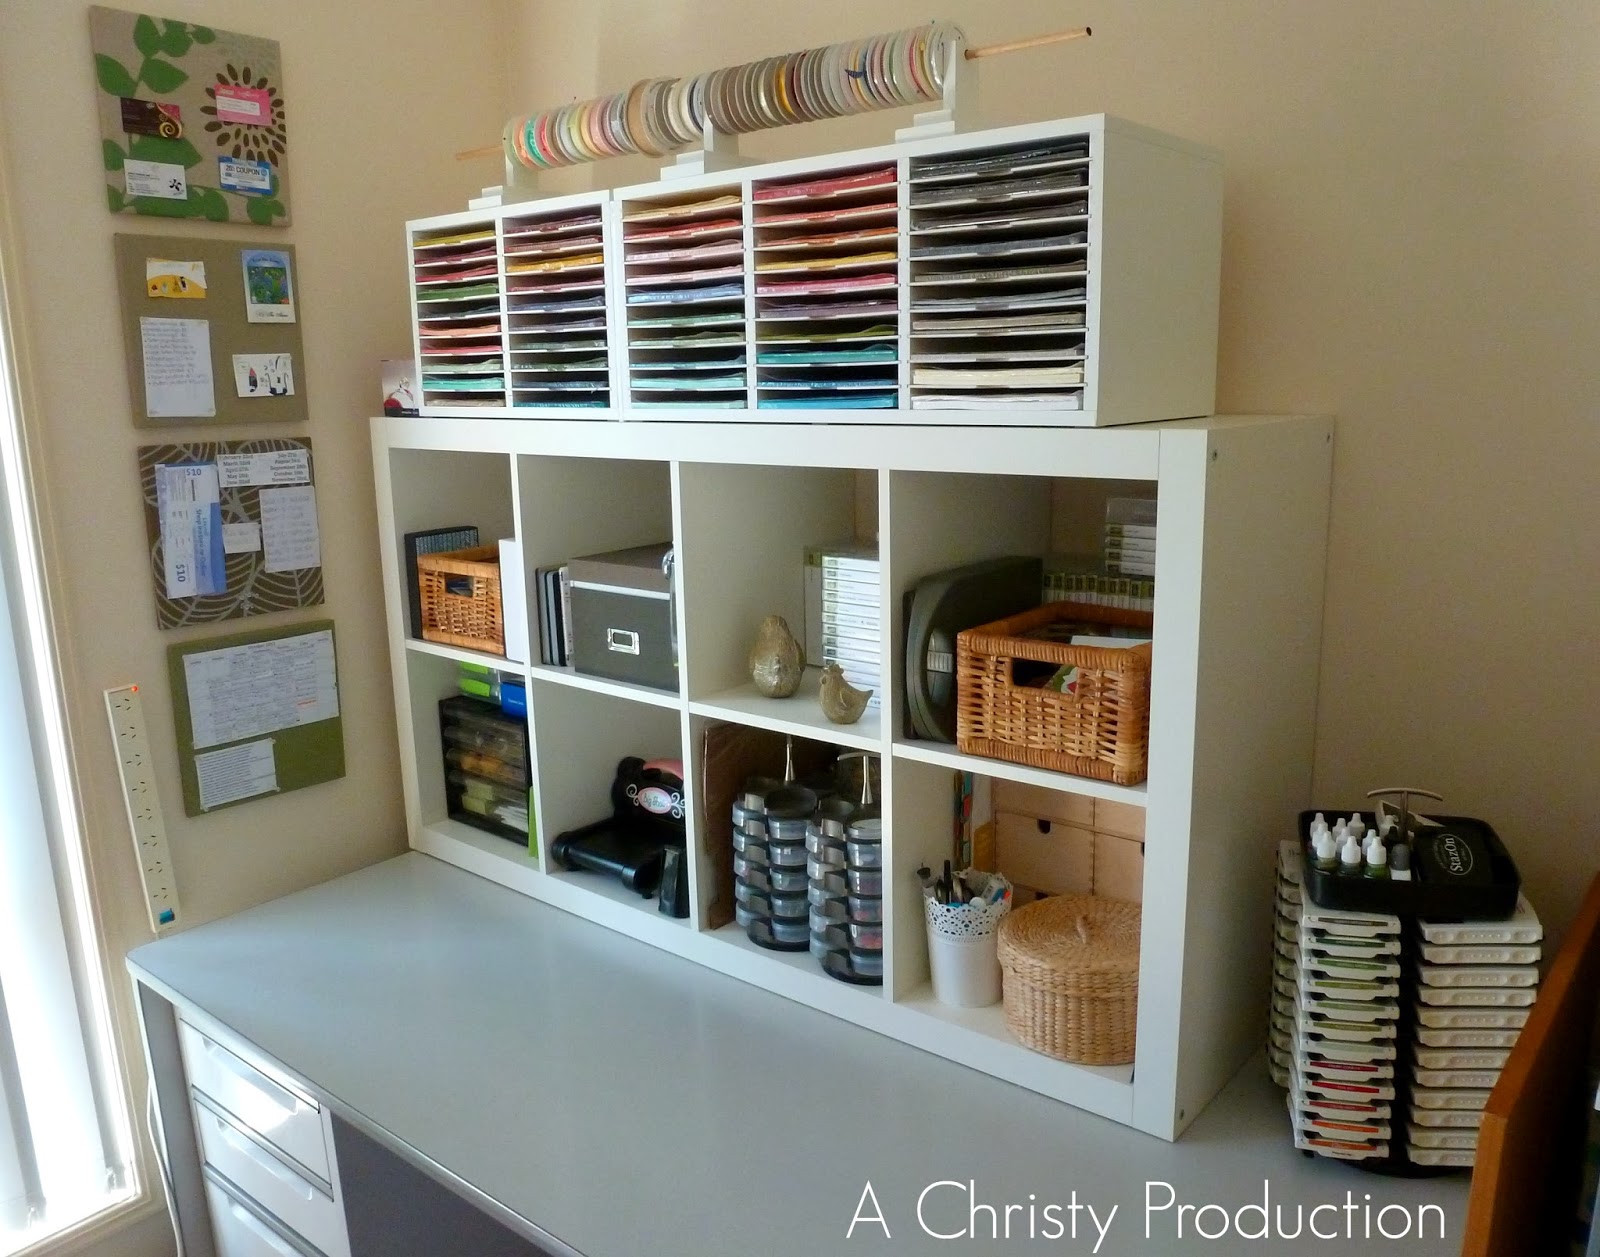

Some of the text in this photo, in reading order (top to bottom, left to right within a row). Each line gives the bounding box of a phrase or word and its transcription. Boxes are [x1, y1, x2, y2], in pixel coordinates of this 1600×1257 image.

[236, 166, 260, 175] COUPON
[186, 468, 202, 476] $10
[175, 563, 187, 583] $10
[1444, 837, 1464, 872] StazOn
